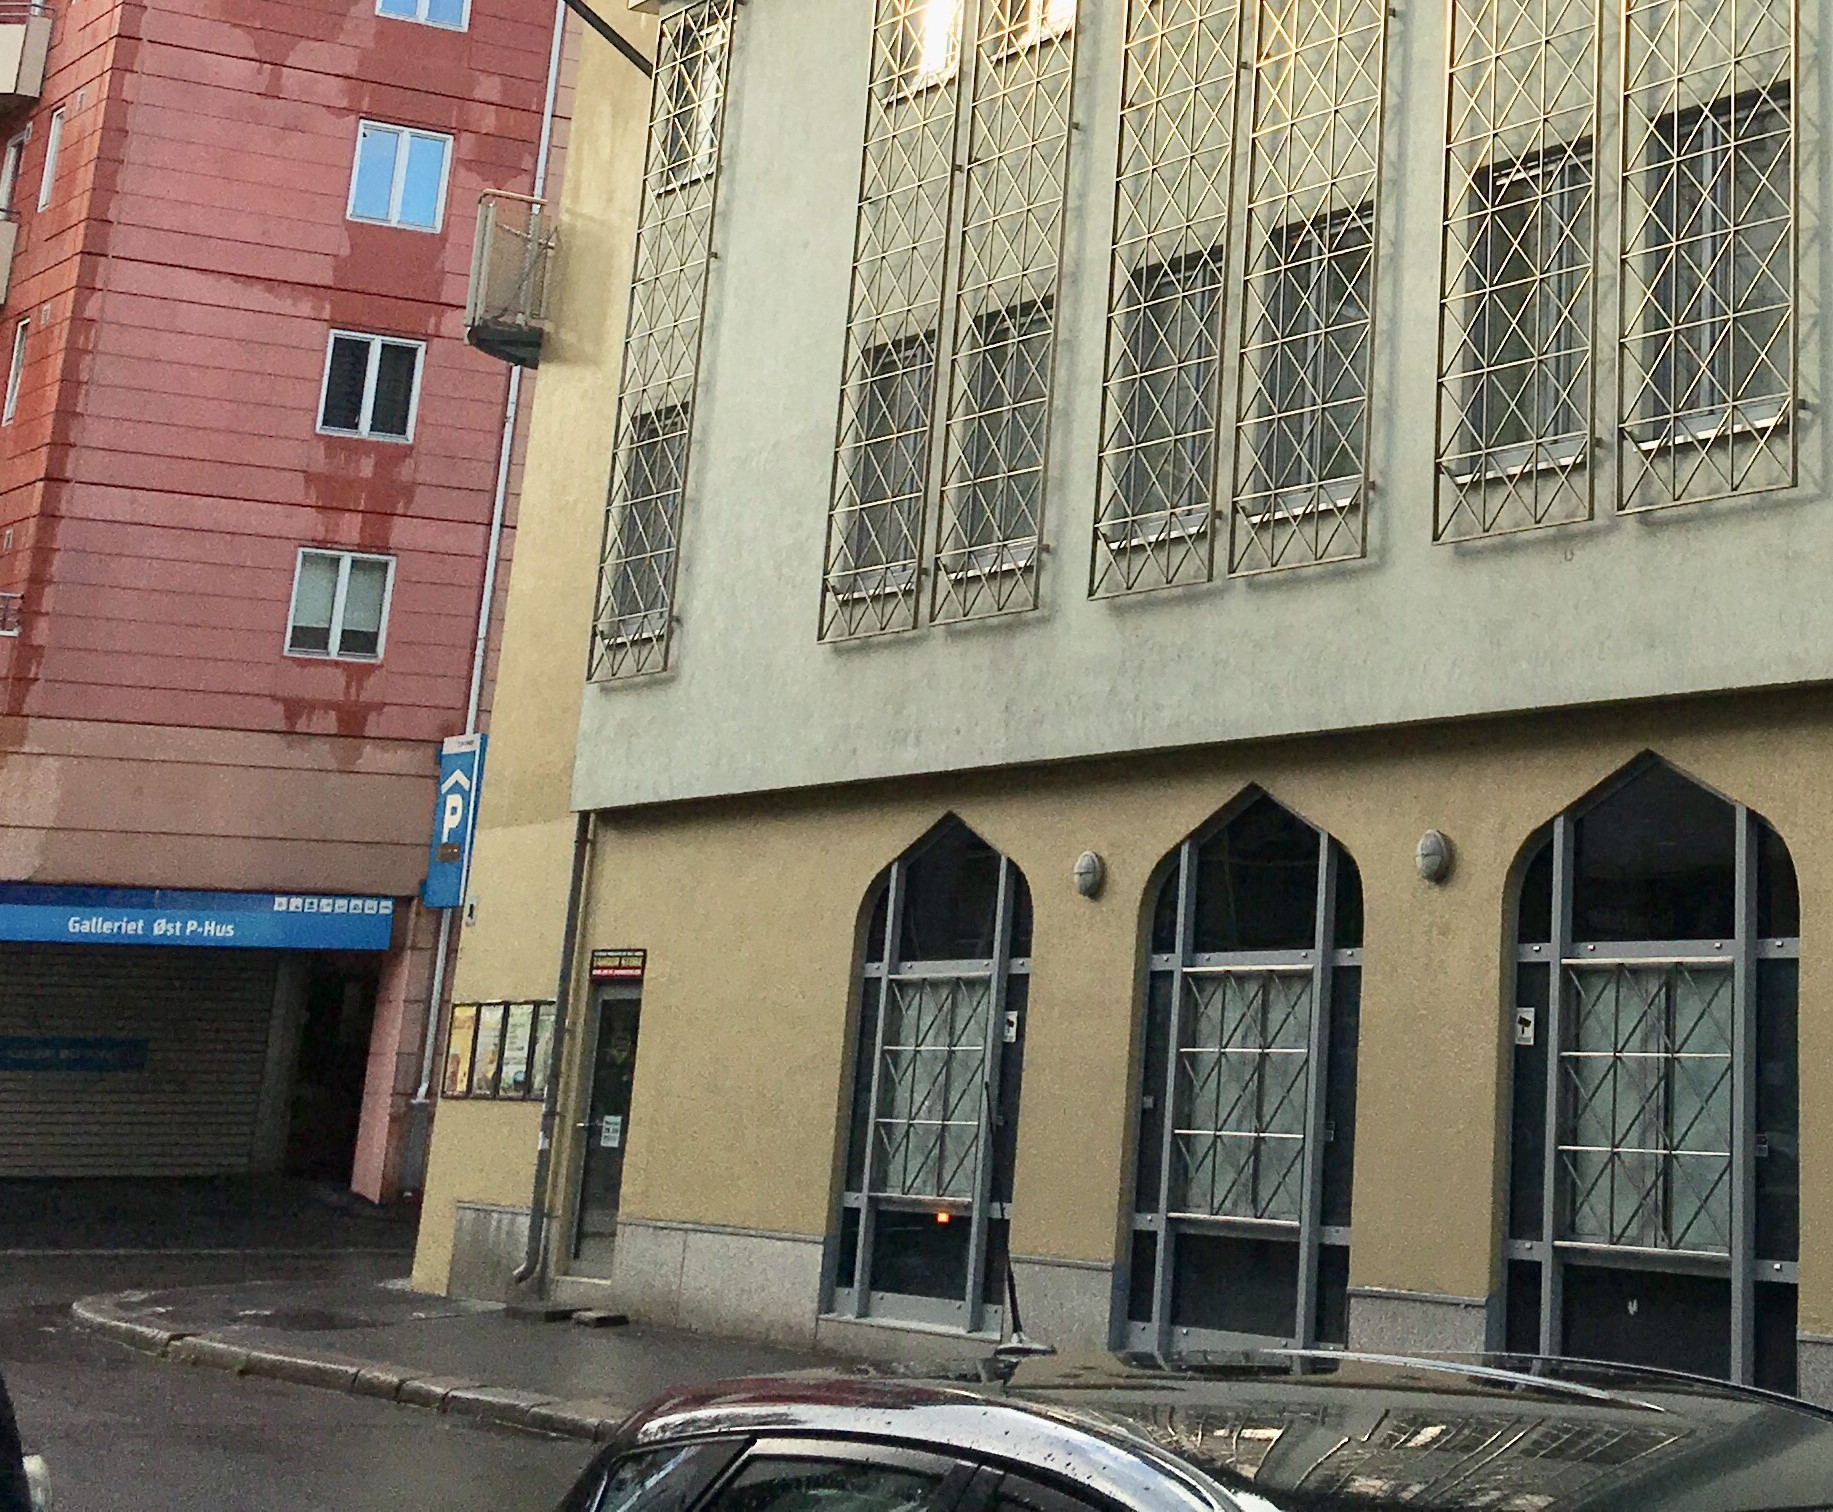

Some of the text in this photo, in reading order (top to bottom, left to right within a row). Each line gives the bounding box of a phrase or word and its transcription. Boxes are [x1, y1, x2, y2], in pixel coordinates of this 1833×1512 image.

[441, 794, 463, 844] P
[68, 916, 235, 937] Galleriet Øst P-Hus
